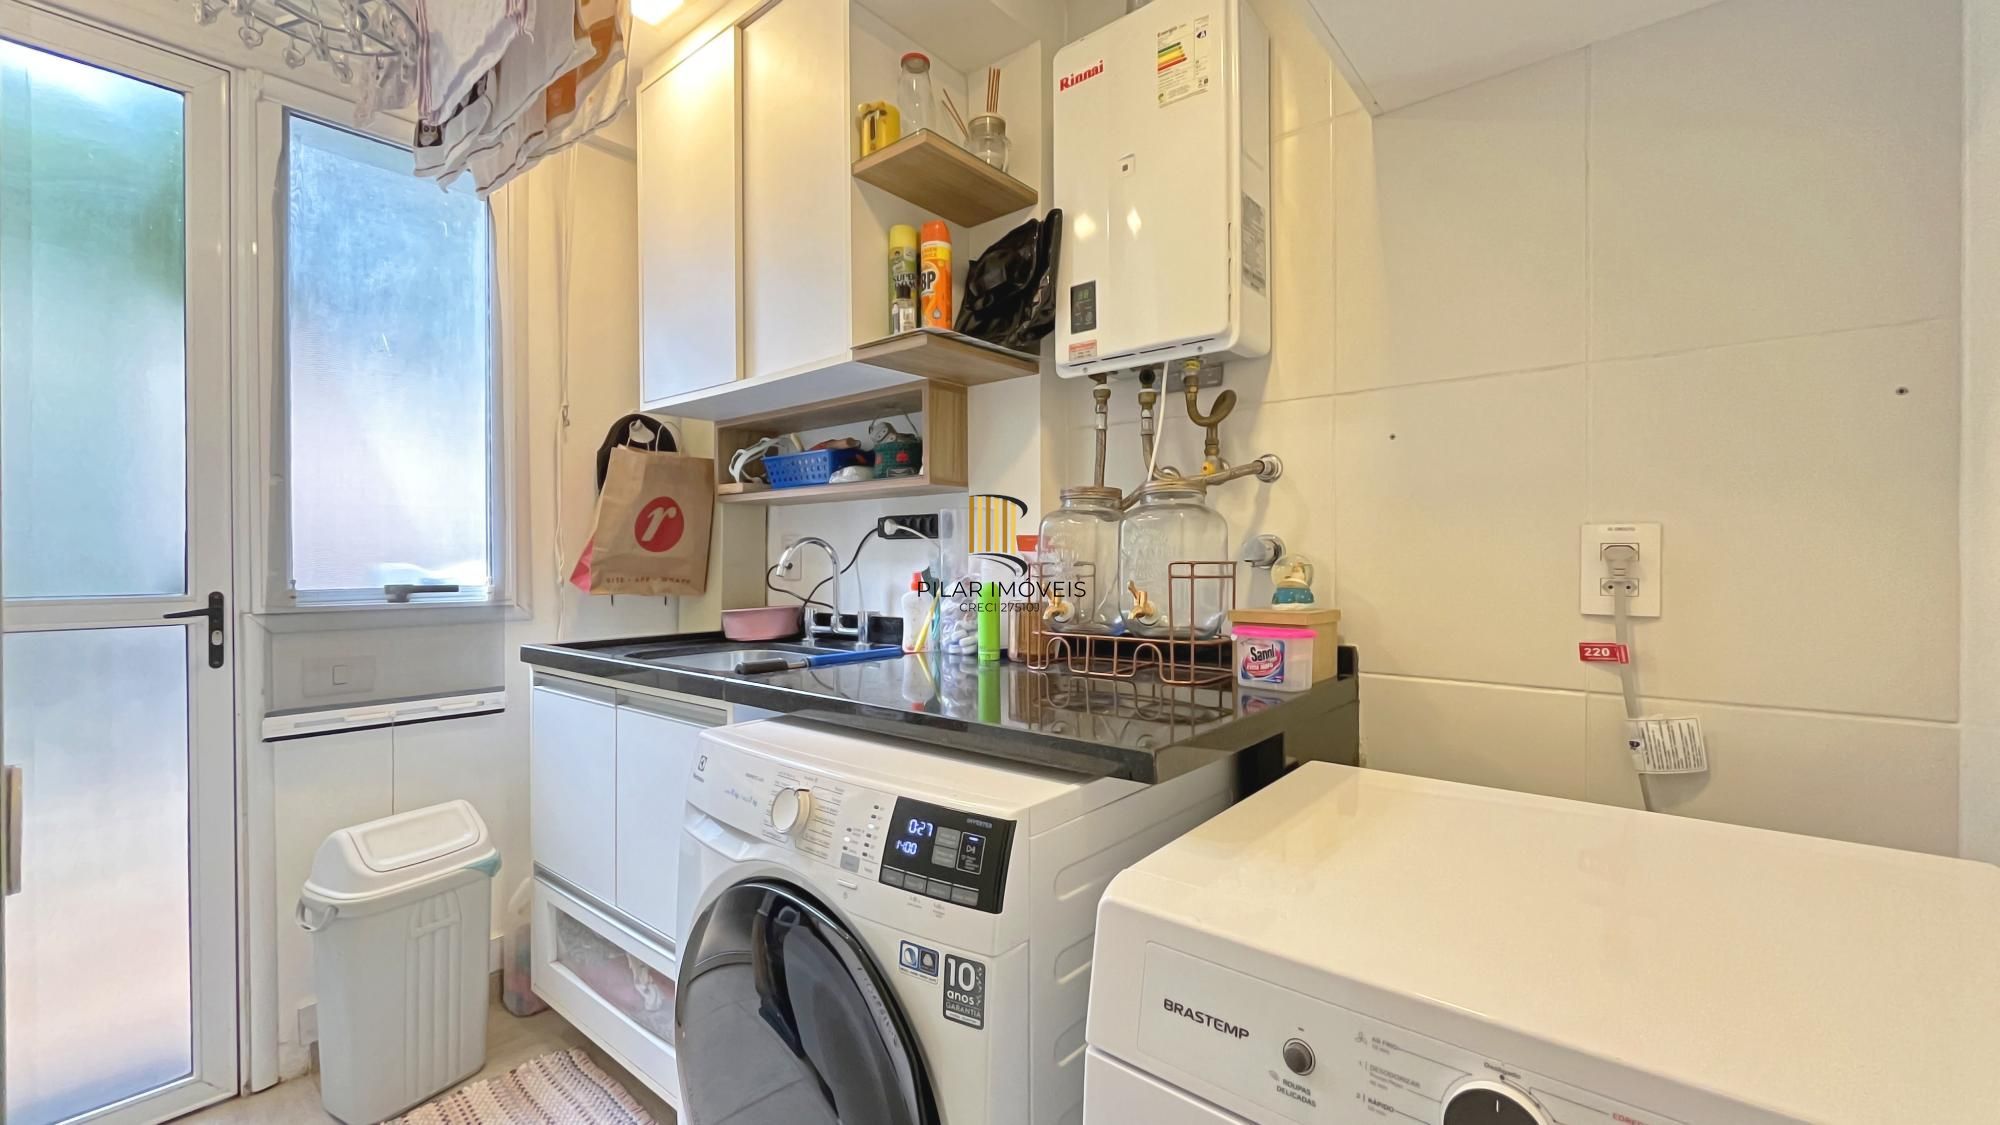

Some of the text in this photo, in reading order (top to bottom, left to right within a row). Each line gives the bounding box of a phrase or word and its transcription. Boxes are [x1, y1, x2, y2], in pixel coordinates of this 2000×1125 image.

[1060, 60, 1104, 91] Rinnai
[1584, 647, 1610, 657] 220
[909, 819, 933, 837] 0:27
[948, 958, 976, 992] 10
[947, 990, 974, 1005] anos
[945, 1002, 981, 1018] GARANTIA
[1164, 998, 1249, 1040] BRASTEMP
[1282, 1078, 1311, 1096] ROUPAS
[1276, 1086, 1317, 1108] DELICADAS
